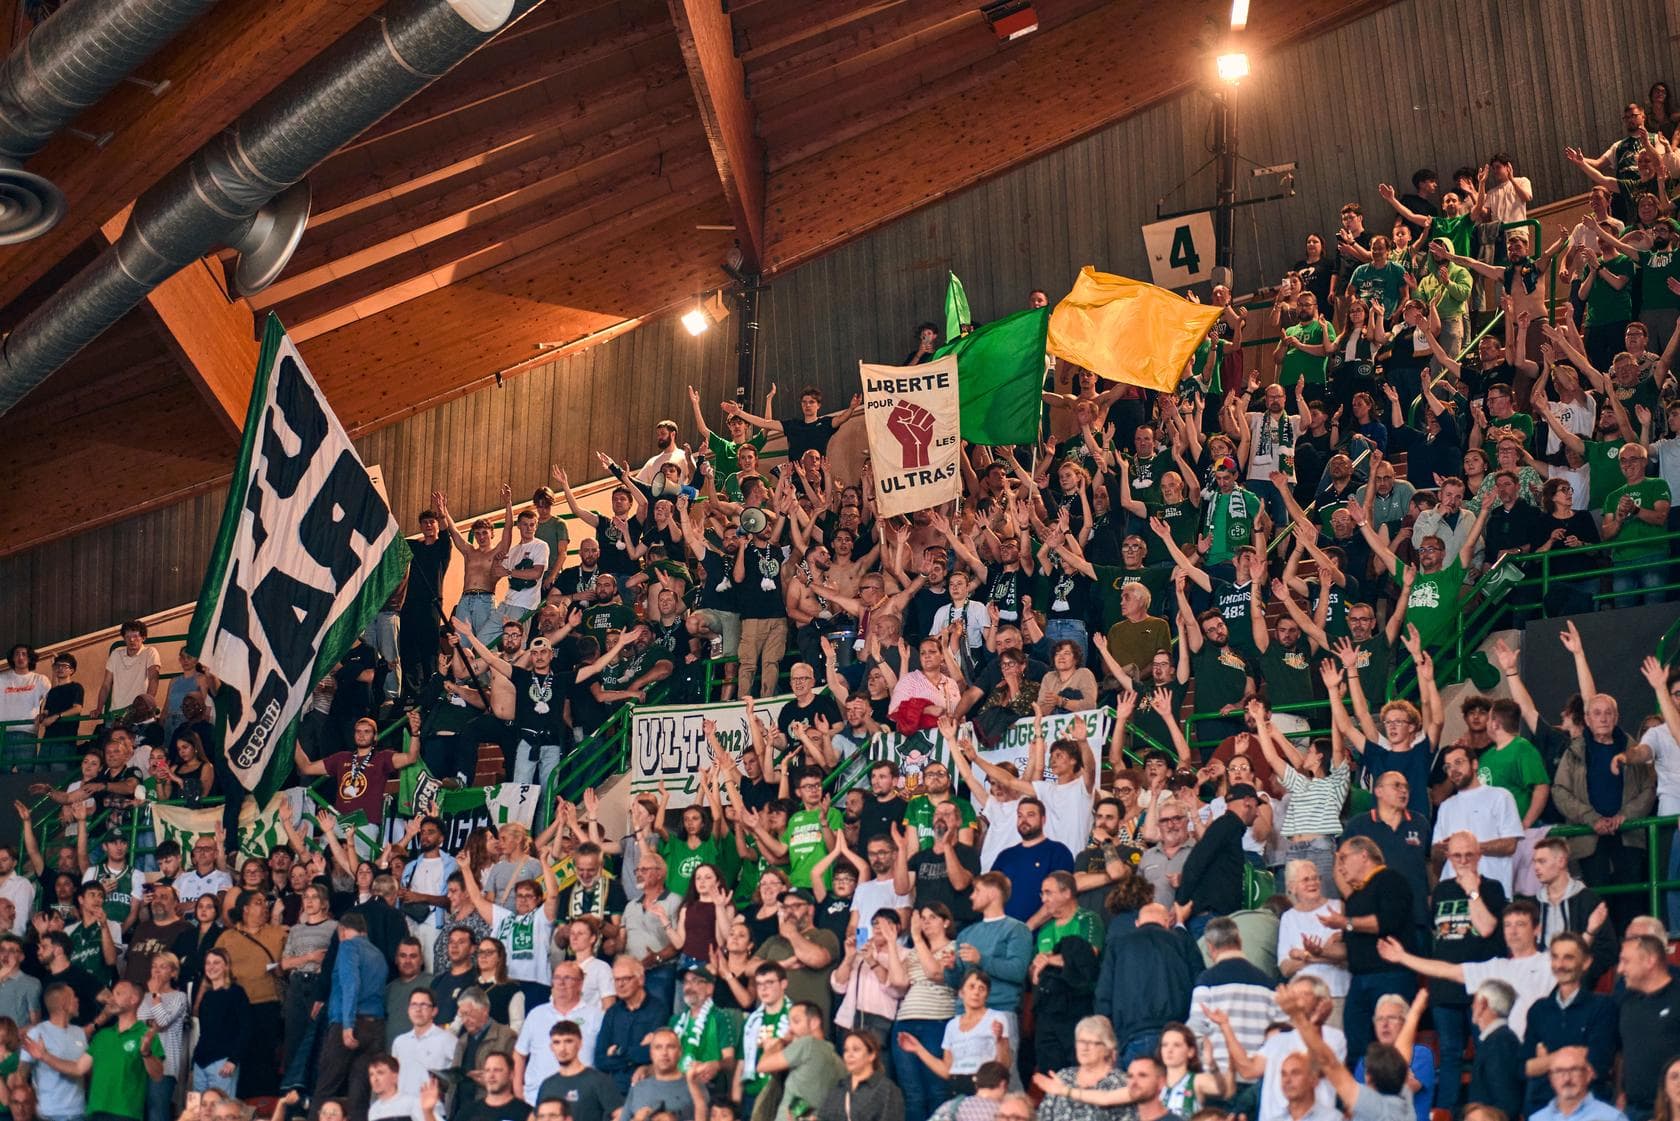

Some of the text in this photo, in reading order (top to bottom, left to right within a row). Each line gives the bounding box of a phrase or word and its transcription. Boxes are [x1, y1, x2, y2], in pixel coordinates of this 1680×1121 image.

[1169, 224, 1201, 275] 4
[867, 372, 950, 394] LIBERTE
[867, 398, 894, 410] POUR
[936, 436, 956, 447] LES
[880, 463, 956, 494] ULTRAS
[1054, 713, 1098, 741] FAS
